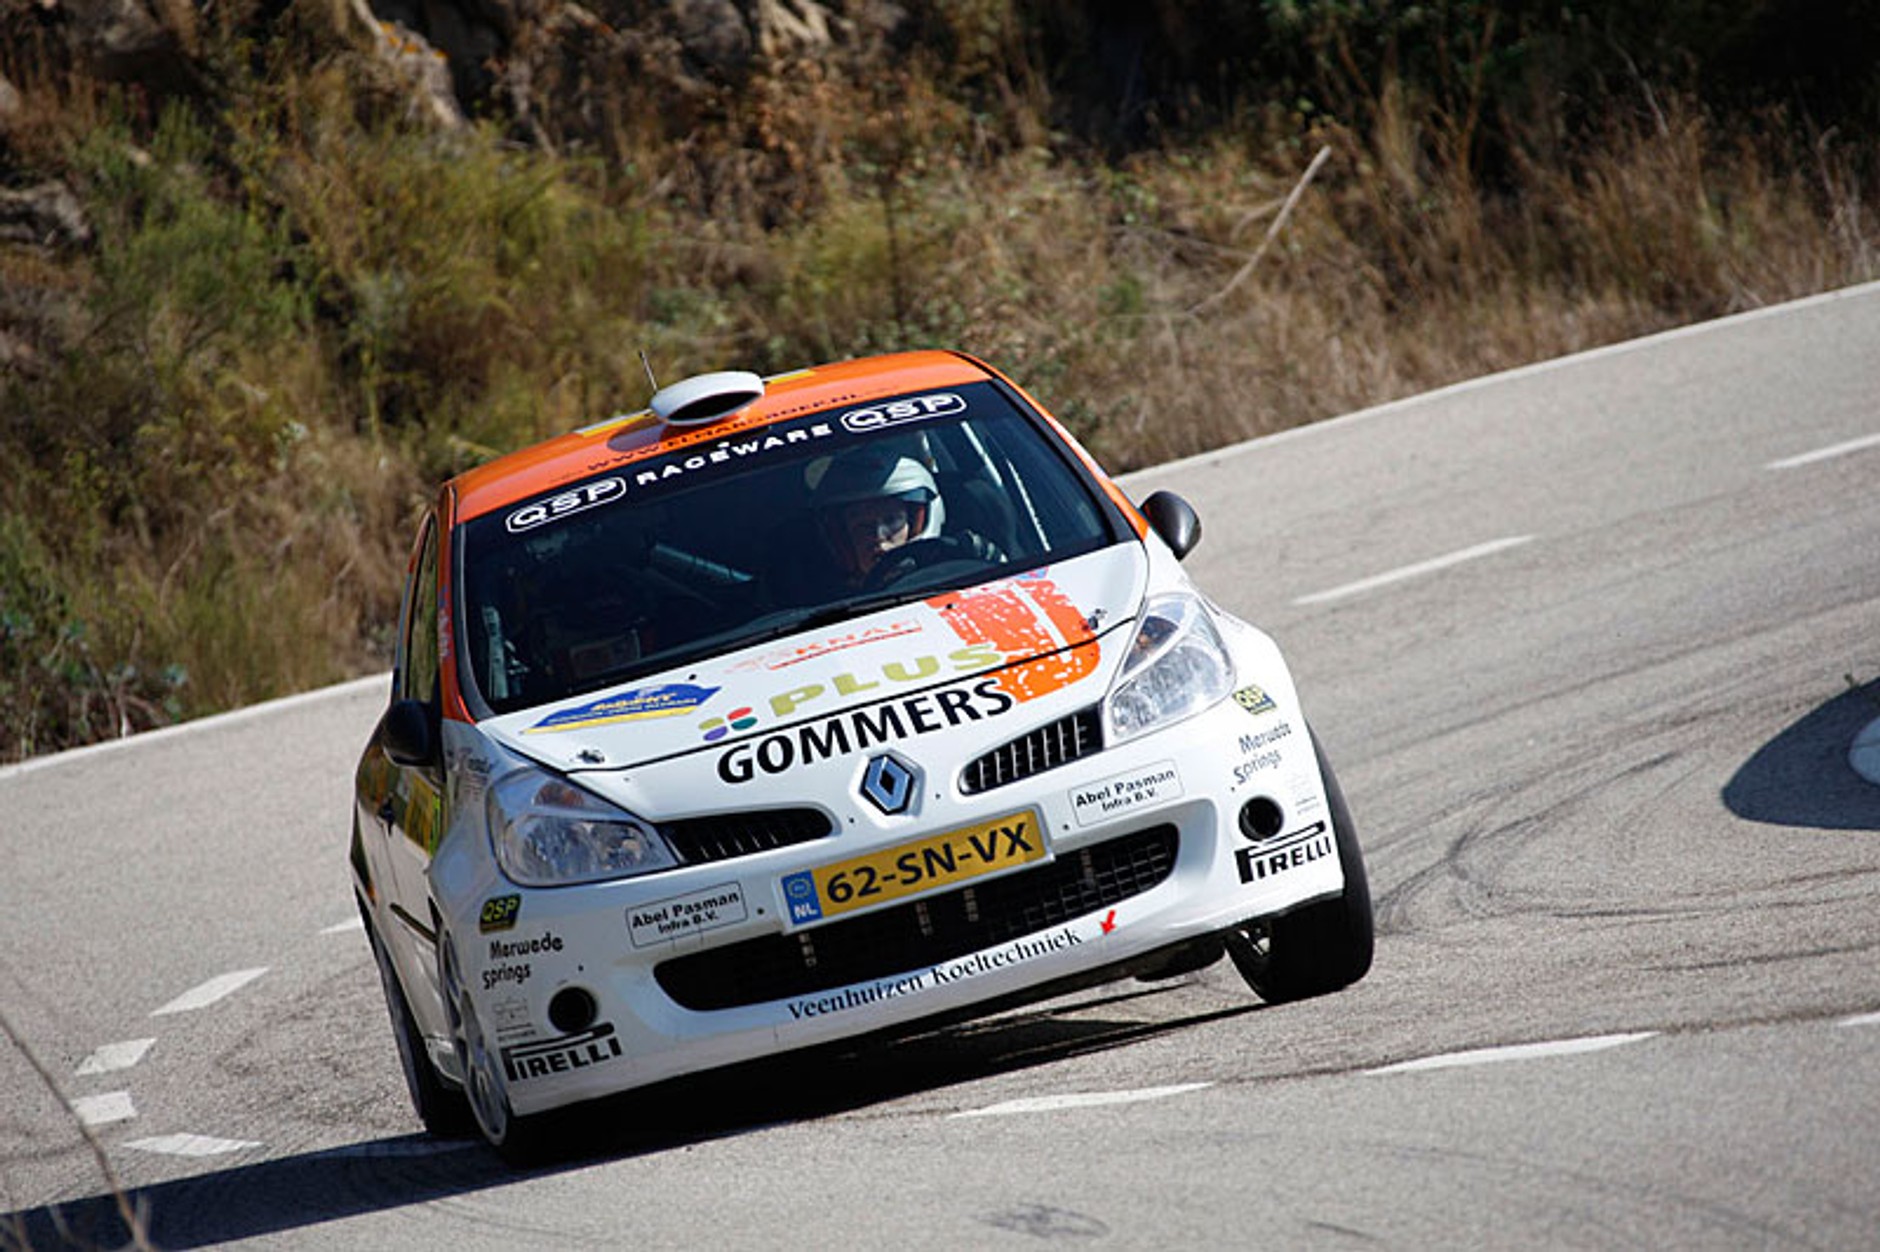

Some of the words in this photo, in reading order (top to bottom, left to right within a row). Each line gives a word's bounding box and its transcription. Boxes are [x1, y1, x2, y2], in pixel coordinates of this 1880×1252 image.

[512, 478, 619, 528] QSP
[636, 424, 832, 487] RACEWARE
[846, 396, 956, 428] QSP
[769, 643, 1002, 716] PLUS
[716, 679, 1013, 784] GOMMERS
[1075, 788, 1111, 808] Abel
[1115, 769, 1176, 795] Pasman
[1101, 795, 1133, 812] Infra
[826, 821, 1034, 904] 62-SN-VX
[1234, 821, 1332, 884] PIRELLI
[482, 897, 518, 922] QSP
[632, 906, 670, 930] Abel
[672, 890, 740, 919] Pasman
[658, 918, 691, 935] Infra
[793, 902, 819, 921] NL
[489, 931, 563, 960] Merwede
[787, 974, 925, 1020] Veenhuizen
[932, 927, 1083, 986] Koeltechniek
[501, 1022, 623, 1082] PIRELLI
